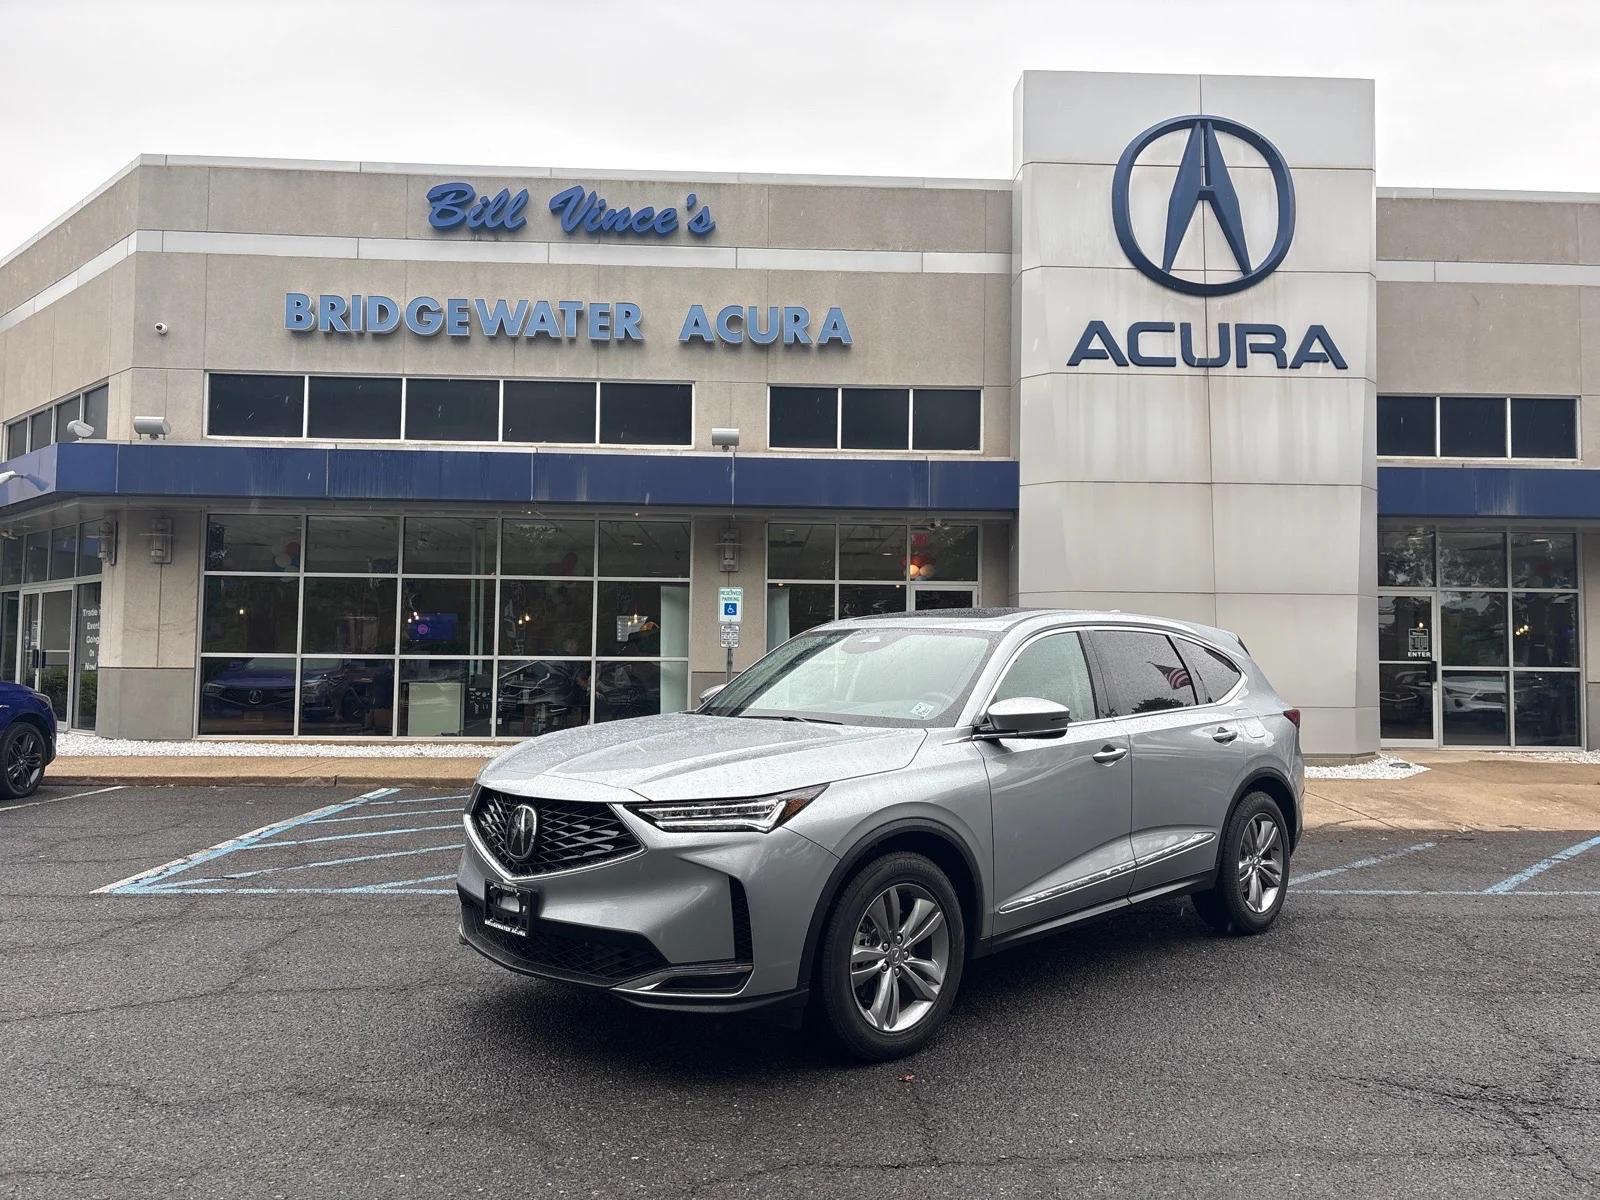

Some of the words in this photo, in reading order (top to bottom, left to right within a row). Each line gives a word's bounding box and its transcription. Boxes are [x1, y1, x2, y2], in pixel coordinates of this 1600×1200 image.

[426, 182, 529, 233] Bill
[549, 185, 717, 235] Vince's
[284, 292, 644, 342] BRIDGEWATER
[678, 304, 853, 346] ACURA
[1066, 320, 1349, 370] ACURA
[83, 608, 98, 617] Trade
[86, 636, 100, 644] Going
